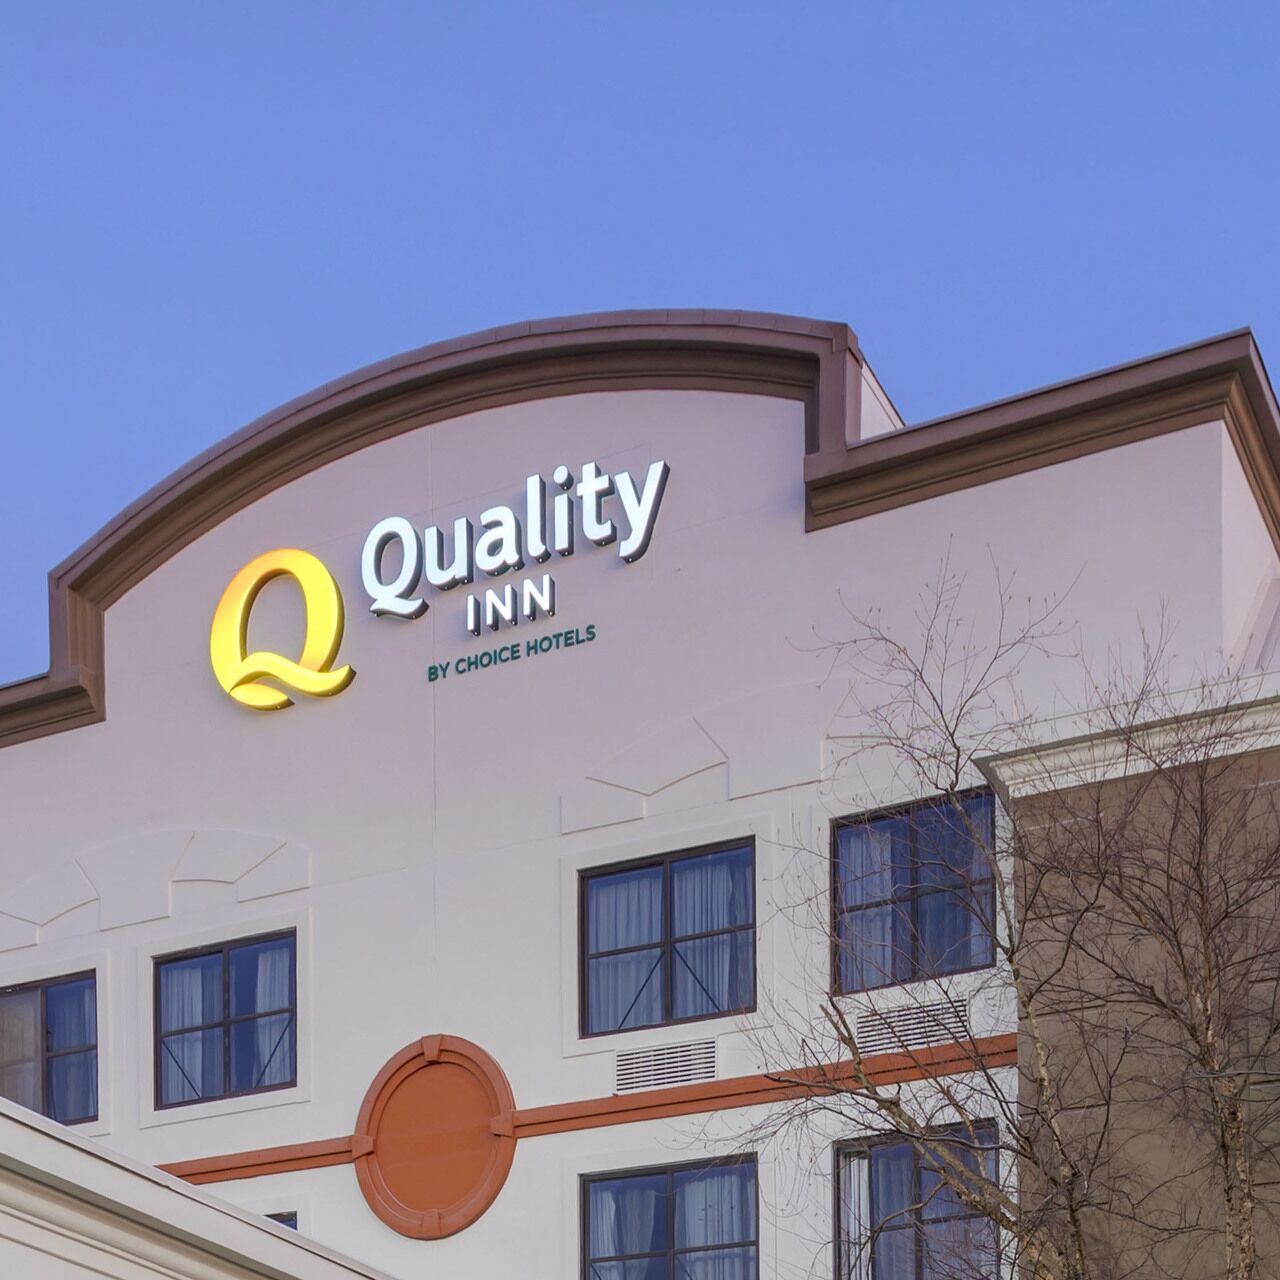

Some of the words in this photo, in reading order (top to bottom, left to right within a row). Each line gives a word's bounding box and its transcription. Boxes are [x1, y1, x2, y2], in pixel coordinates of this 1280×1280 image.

[360, 460, 671, 620] Quality
[209, 547, 357, 711] Q
[427, 662, 451, 682] BY
[455, 643, 521, 674] CHOICE
[527, 625, 596, 657] HOTELS
[466, 573, 556, 636] INN
